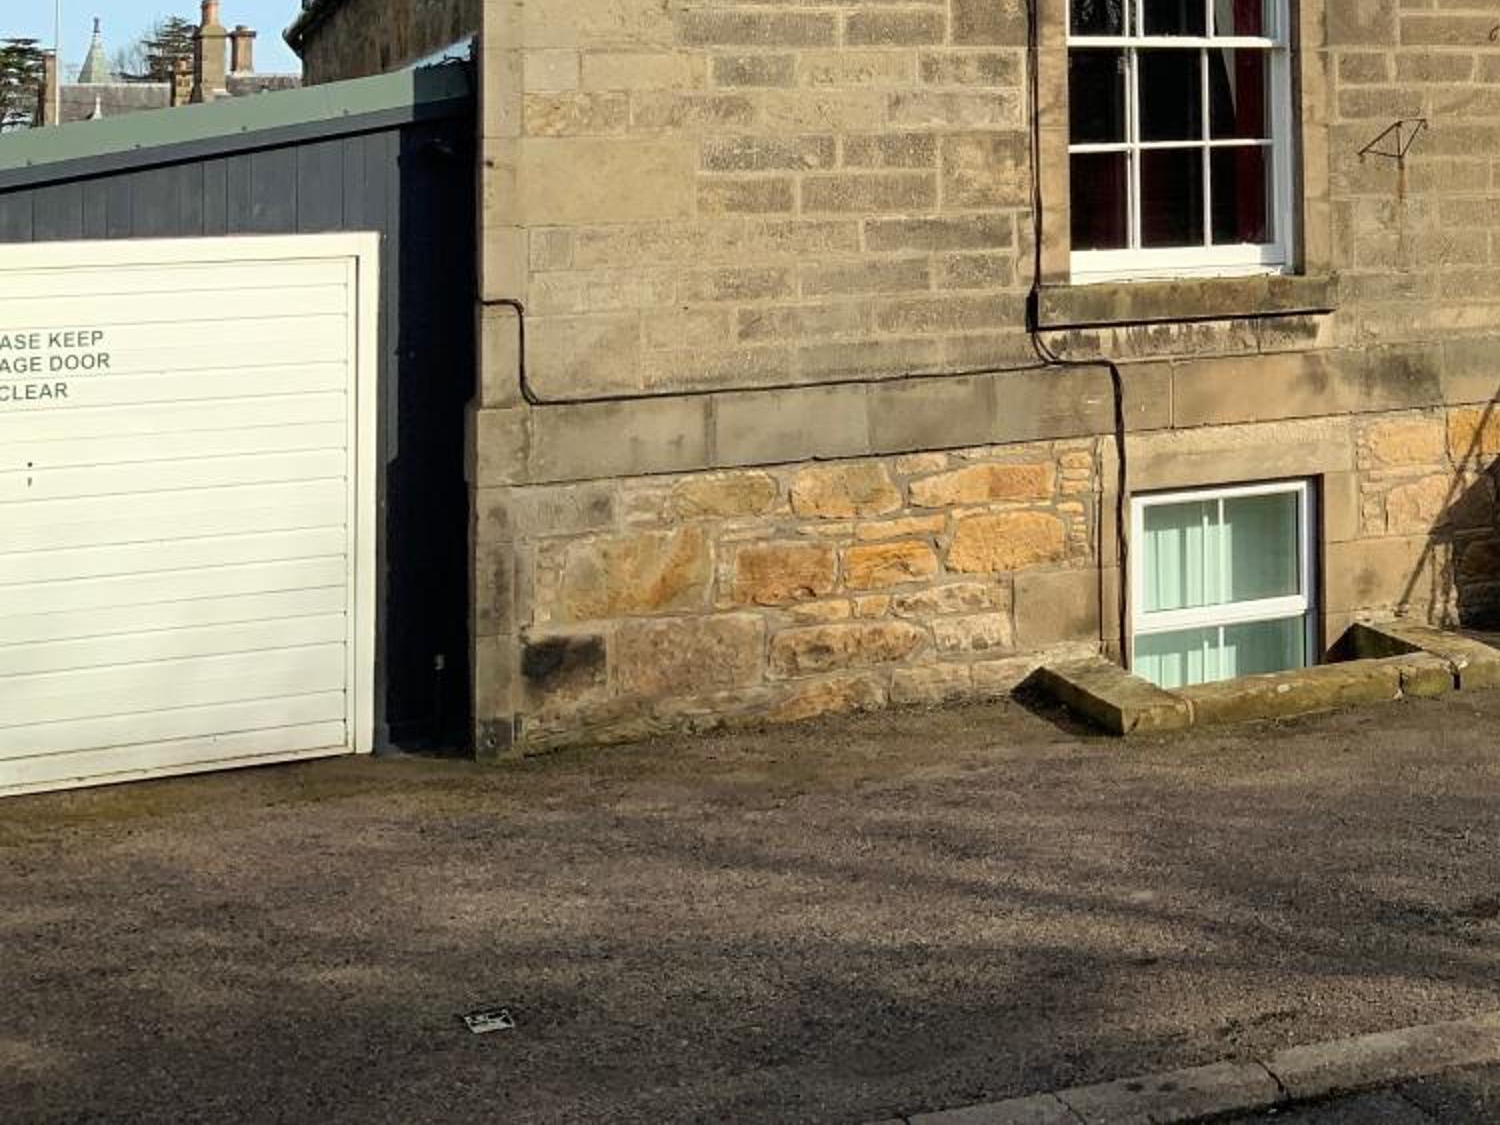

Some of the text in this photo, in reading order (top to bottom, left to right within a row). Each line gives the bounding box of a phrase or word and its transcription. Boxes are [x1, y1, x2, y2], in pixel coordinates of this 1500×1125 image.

[48, 330, 104, 348] KEEP
[49, 352, 111, 372] DOOR
[0, 382, 68, 402] CLEAR
